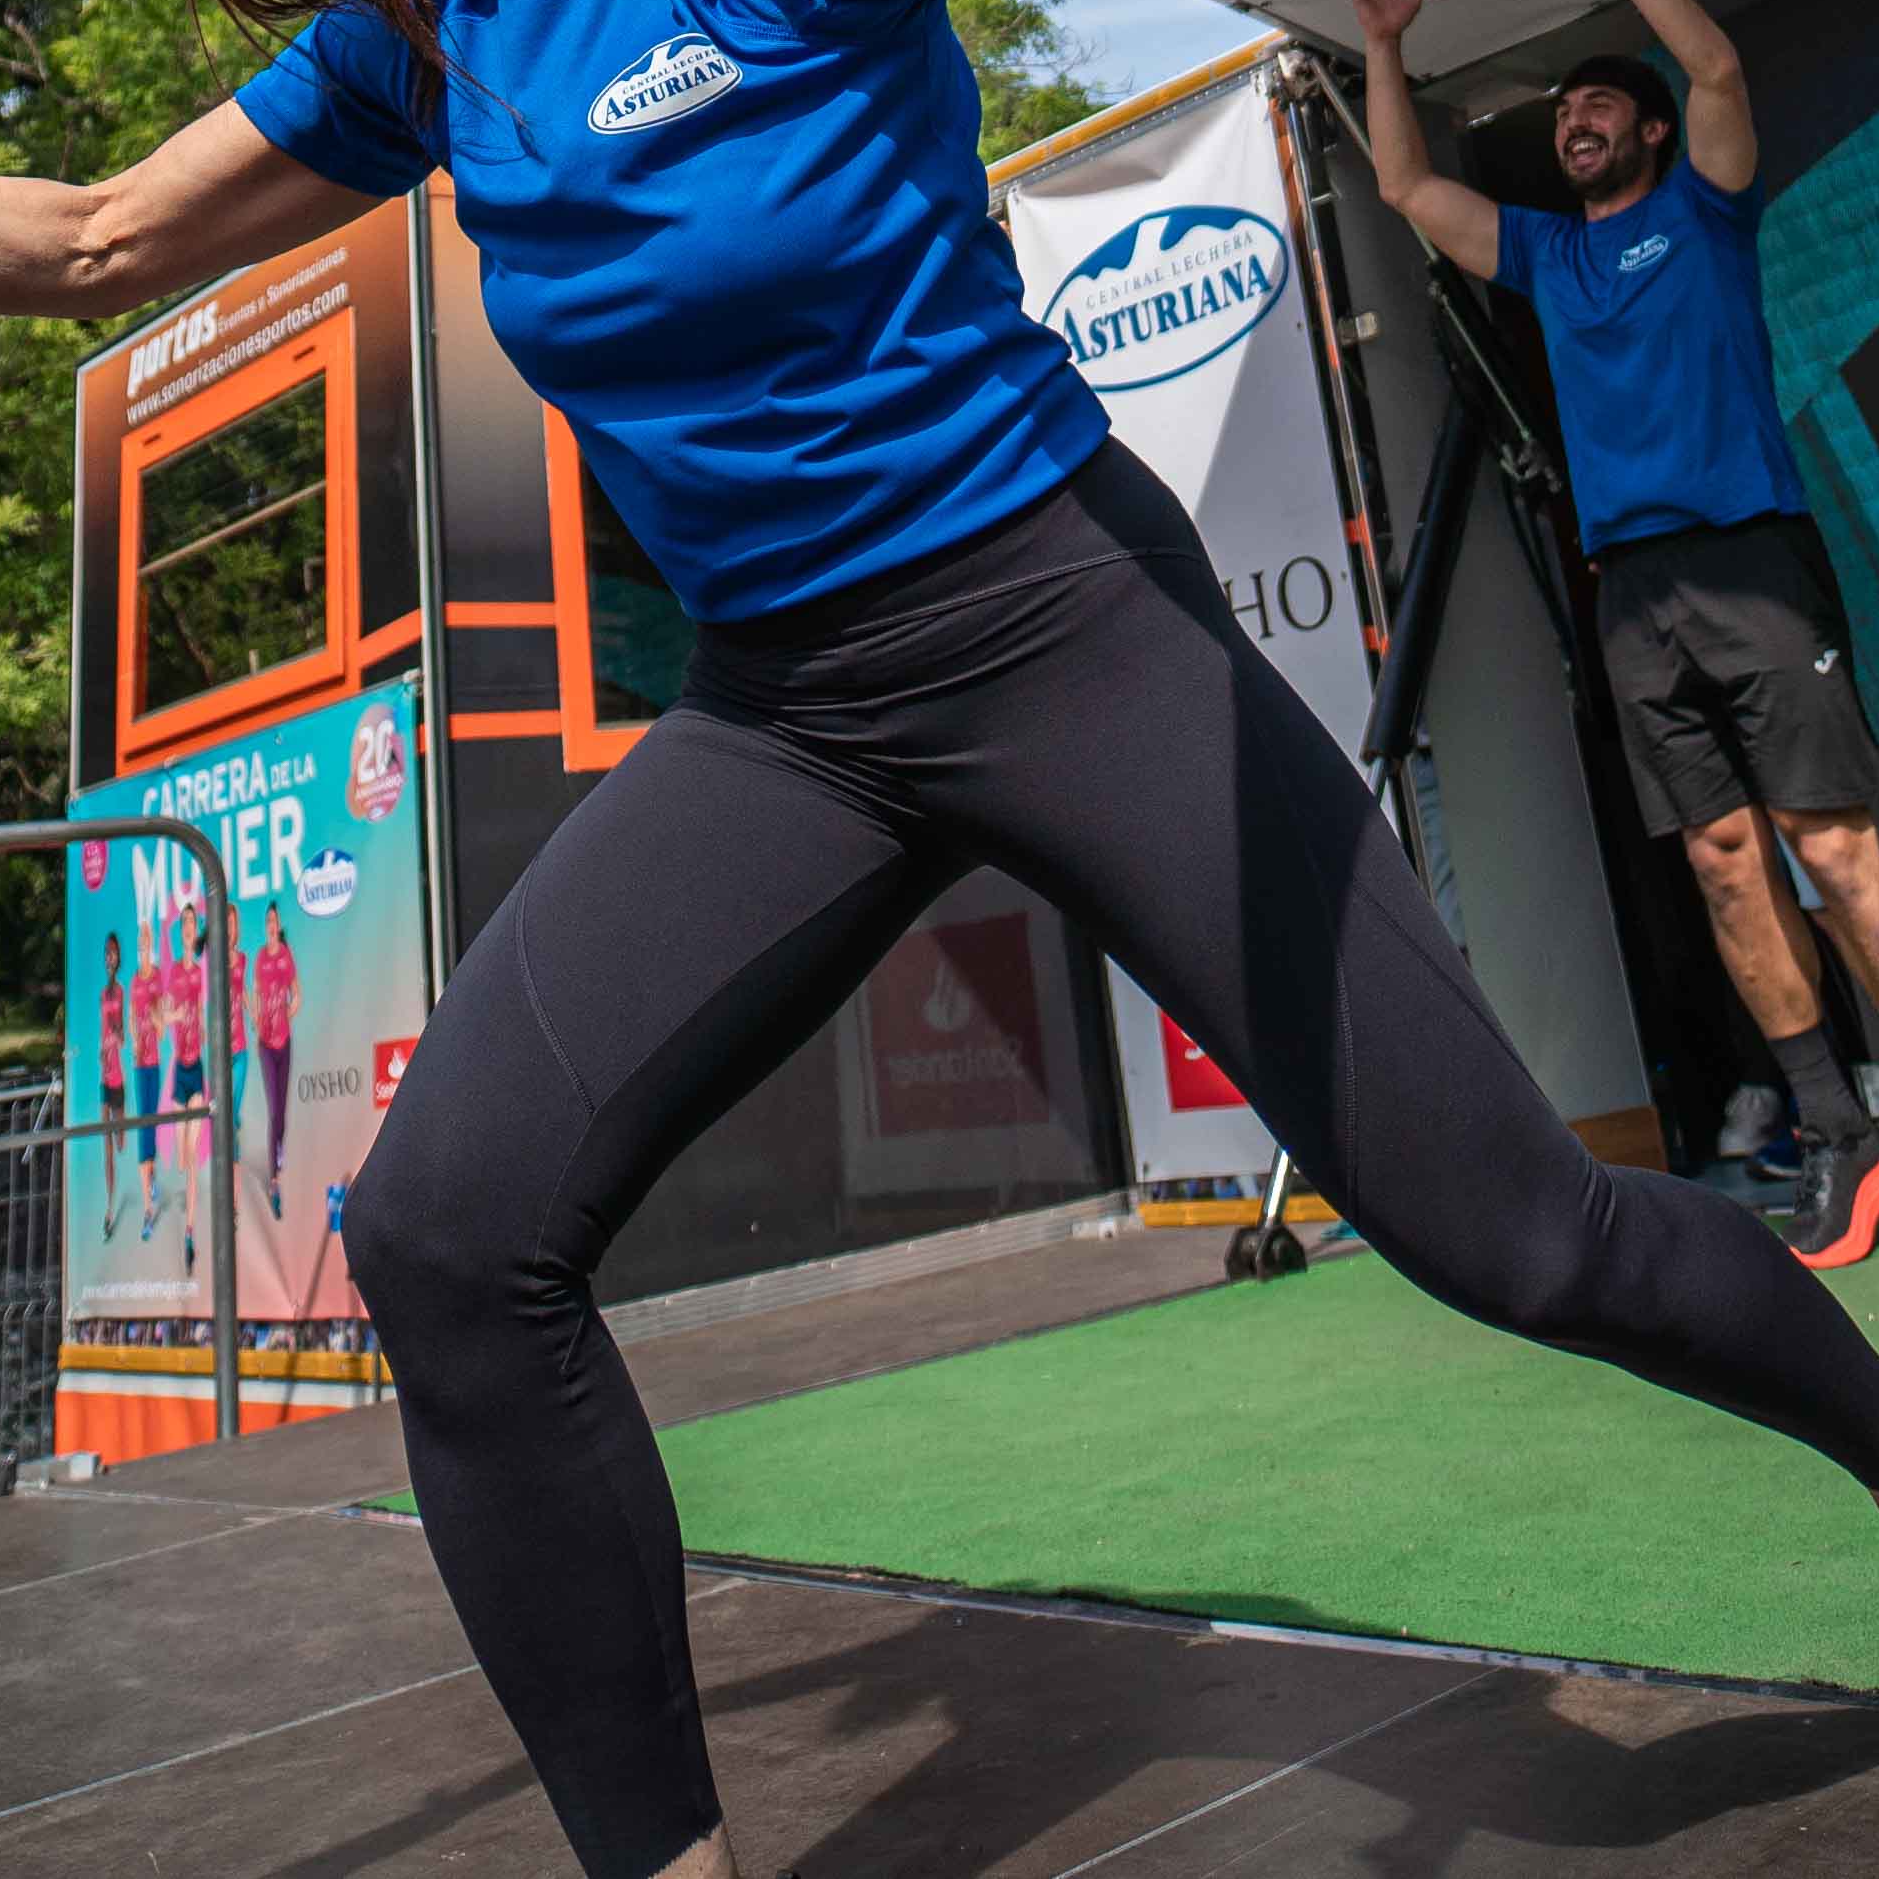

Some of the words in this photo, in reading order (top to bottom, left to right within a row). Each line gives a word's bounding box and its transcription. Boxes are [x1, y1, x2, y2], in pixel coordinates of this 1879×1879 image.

[604, 57, 735, 126] ASTURIANA
[622, 65, 671, 95] CENTRAL
[1085, 268, 1165, 310] CENTRAL
[1172, 230, 1254, 276] LECHERA
[1062, 254, 1274, 364] ASTURIANA
[126, 299, 219, 399] portos
[142, 750, 270, 820] CARRERA
[271, 760, 292, 791] DE
[293, 752, 317, 785] LA
[297, 1065, 360, 1104] OYSHO
